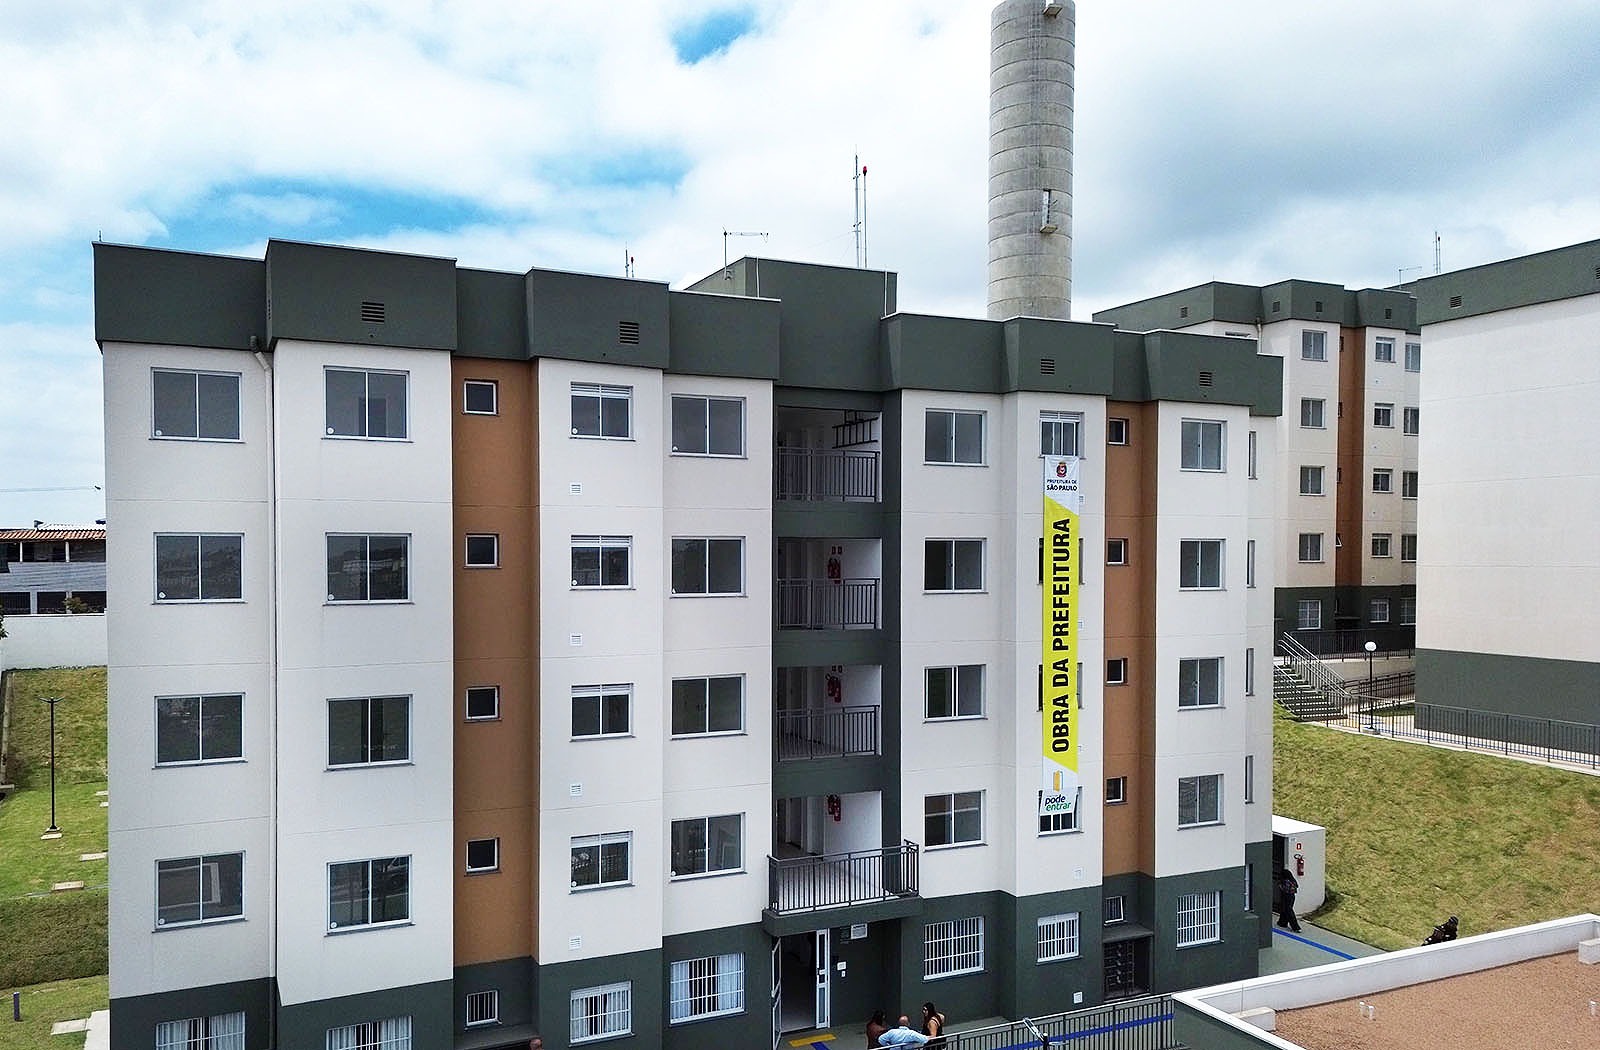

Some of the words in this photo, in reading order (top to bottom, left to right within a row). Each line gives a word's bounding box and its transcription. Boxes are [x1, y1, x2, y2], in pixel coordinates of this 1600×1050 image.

[1052, 518, 1070, 651] PREFEITURA
[1052, 658, 1069, 688] DA
[1052, 693, 1069, 753] OBRA
[1045, 794, 1066, 806] pode
[1046, 802, 1071, 811] entrar
